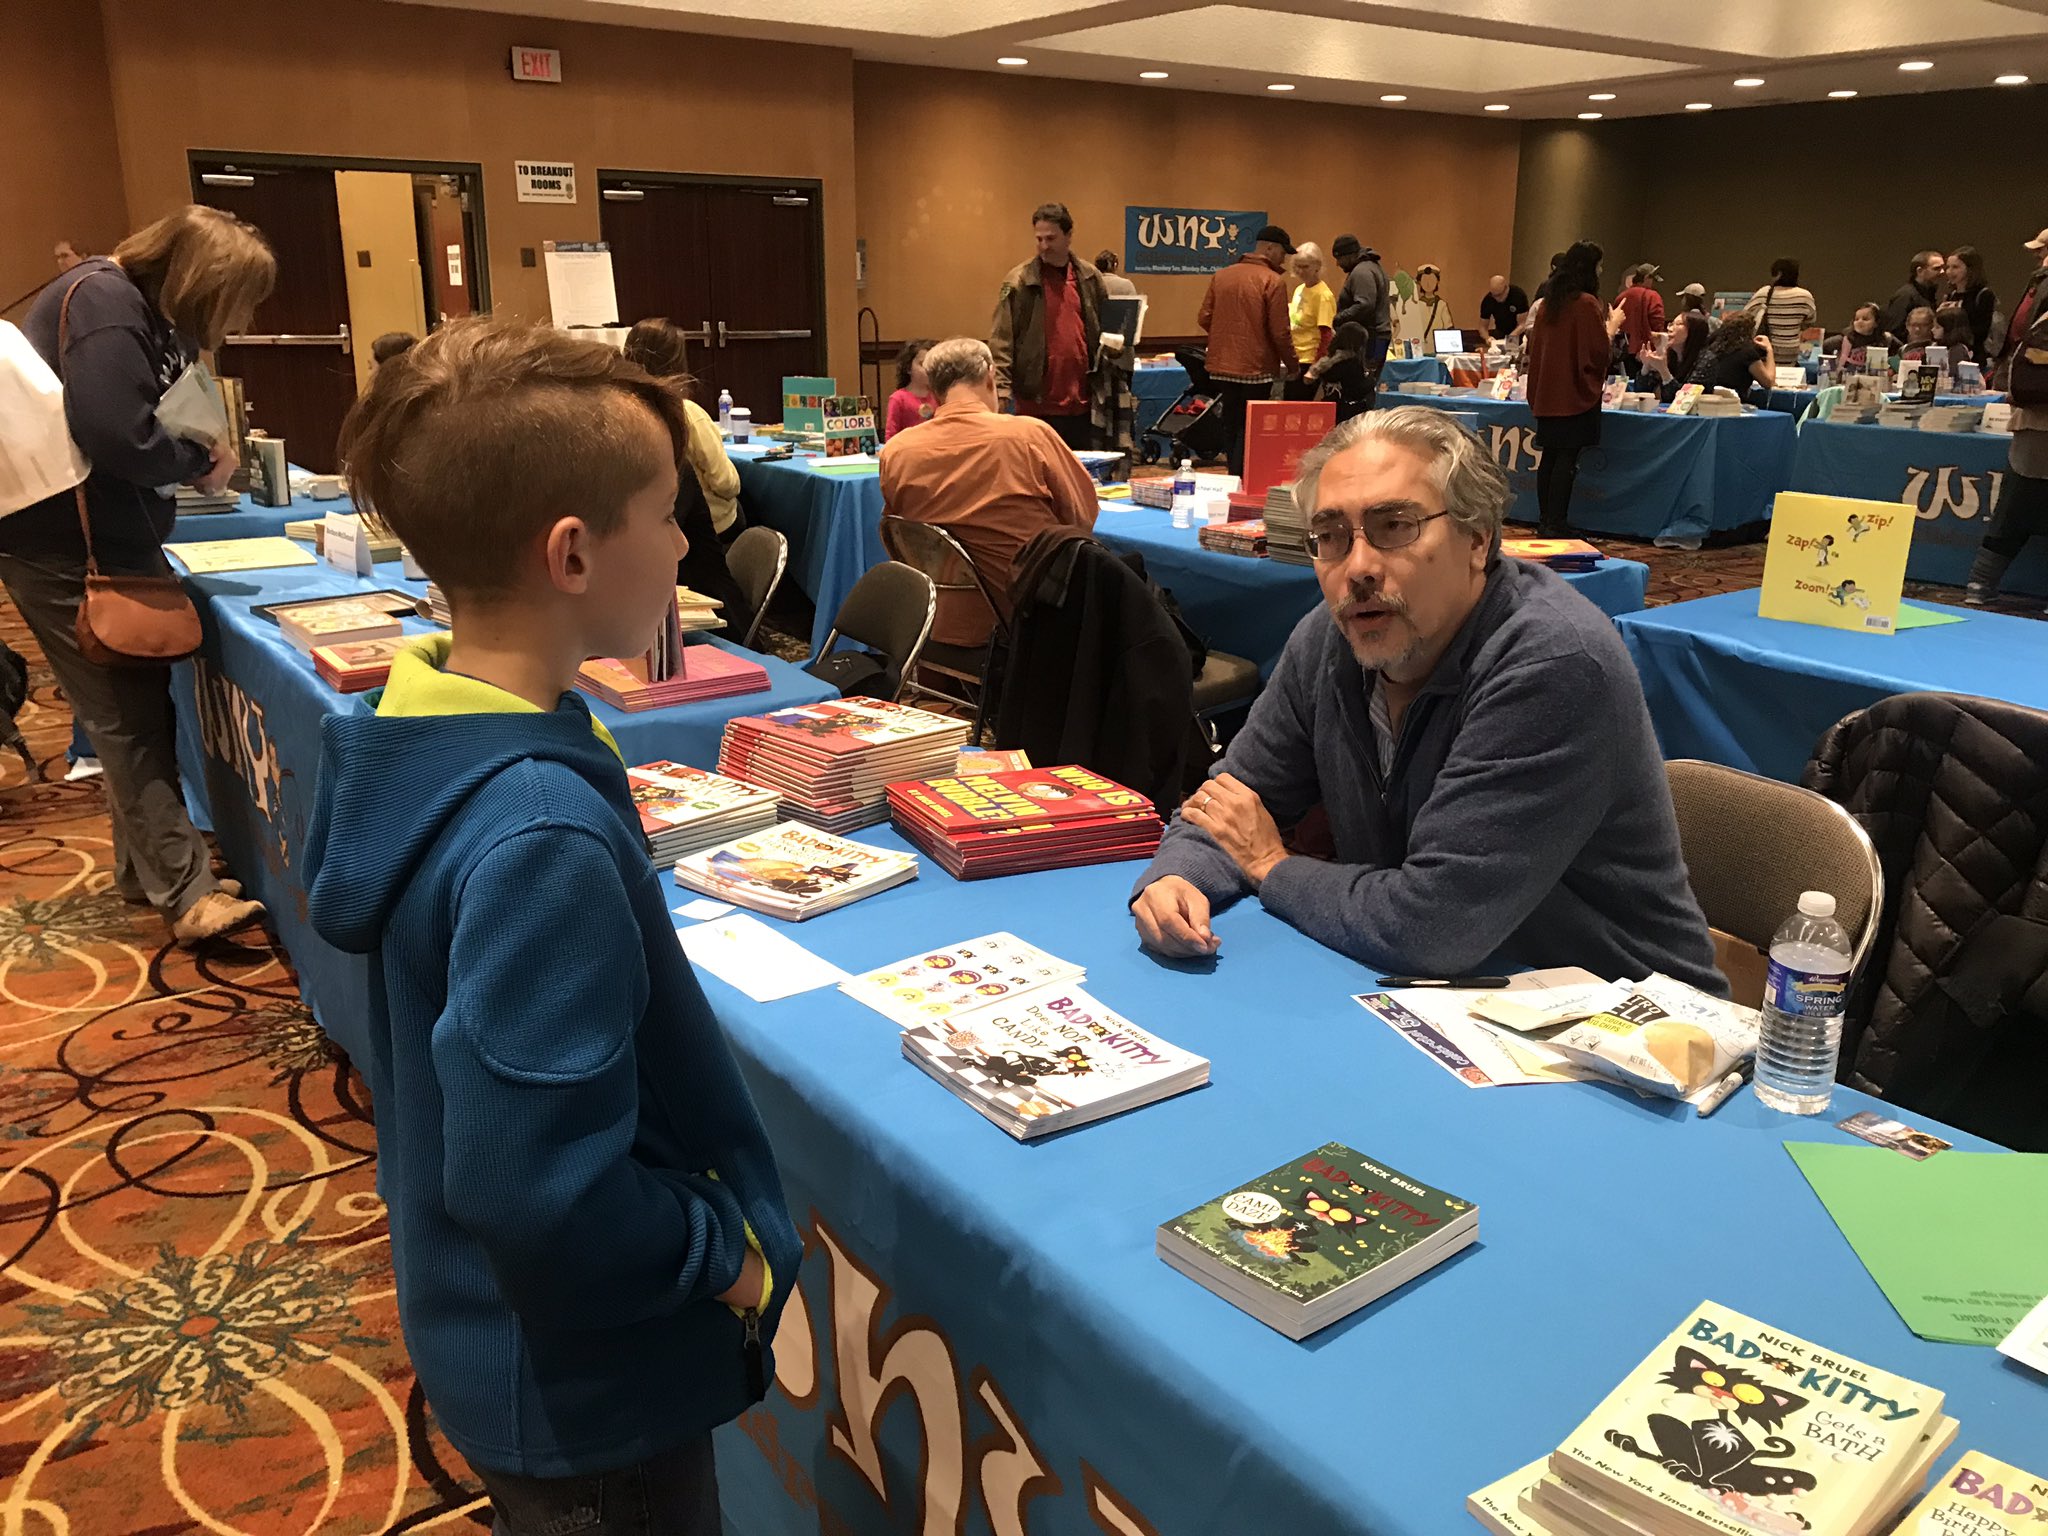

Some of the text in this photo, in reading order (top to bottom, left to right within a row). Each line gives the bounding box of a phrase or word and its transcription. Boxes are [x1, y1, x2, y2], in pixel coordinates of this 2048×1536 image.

[522, 52, 551, 77] EXIT
[518, 165, 573, 177] TO BREAKOUT
[531, 179, 562, 190] ROOMS
[826, 416, 872, 431] COLORS
[923, 778, 1015, 820] BUBBLE?
[957, 775, 1048, 816] MELVIN
[1050, 766, 1143, 806] WHO IS
[781, 829, 816, 846] BAD
[832, 845, 888, 864] KITTY
[1630, 995, 1662, 1014] TRO
[1795, 994, 1842, 1006] SPRING
[1805, 1004, 1836, 1012] WATER
[992, 1016, 1049, 1049] CANDY
[1020, 1017, 1049, 1036] Like
[1025, 1005, 1092, 1044] Does NOT
[1045, 996, 1171, 1065] BAD KITTY
[1103, 1014, 1151, 1044] NICK BRUEL
[1599, 1022, 1621, 1033] CHIPS
[1302, 1156, 1443, 1228] BAD KITTY
[1359, 1161, 1427, 1198] NICK BRUEL
[1226, 1201, 1271, 1221] DAZE
[1233, 1194, 1280, 1213] CAMP
[1174, 1225, 1304, 1298] The New York Times Bestselling Series
[1971, 1326, 2004, 1339] SALE
[1687, 1317, 1920, 1421] BAD KITTY
[1757, 1332, 1869, 1383] NICK BRUEL
[1803, 1421, 1884, 1463] BATH
[1815, 1410, 1886, 1446] Gets a
[1571, 1447, 1754, 1536] The New York Times Bestselli
[1949, 1467, 2034, 1515] BAD
[1481, 1496, 1525, 1532] The New
[1947, 1501, 2017, 1536] Happy
